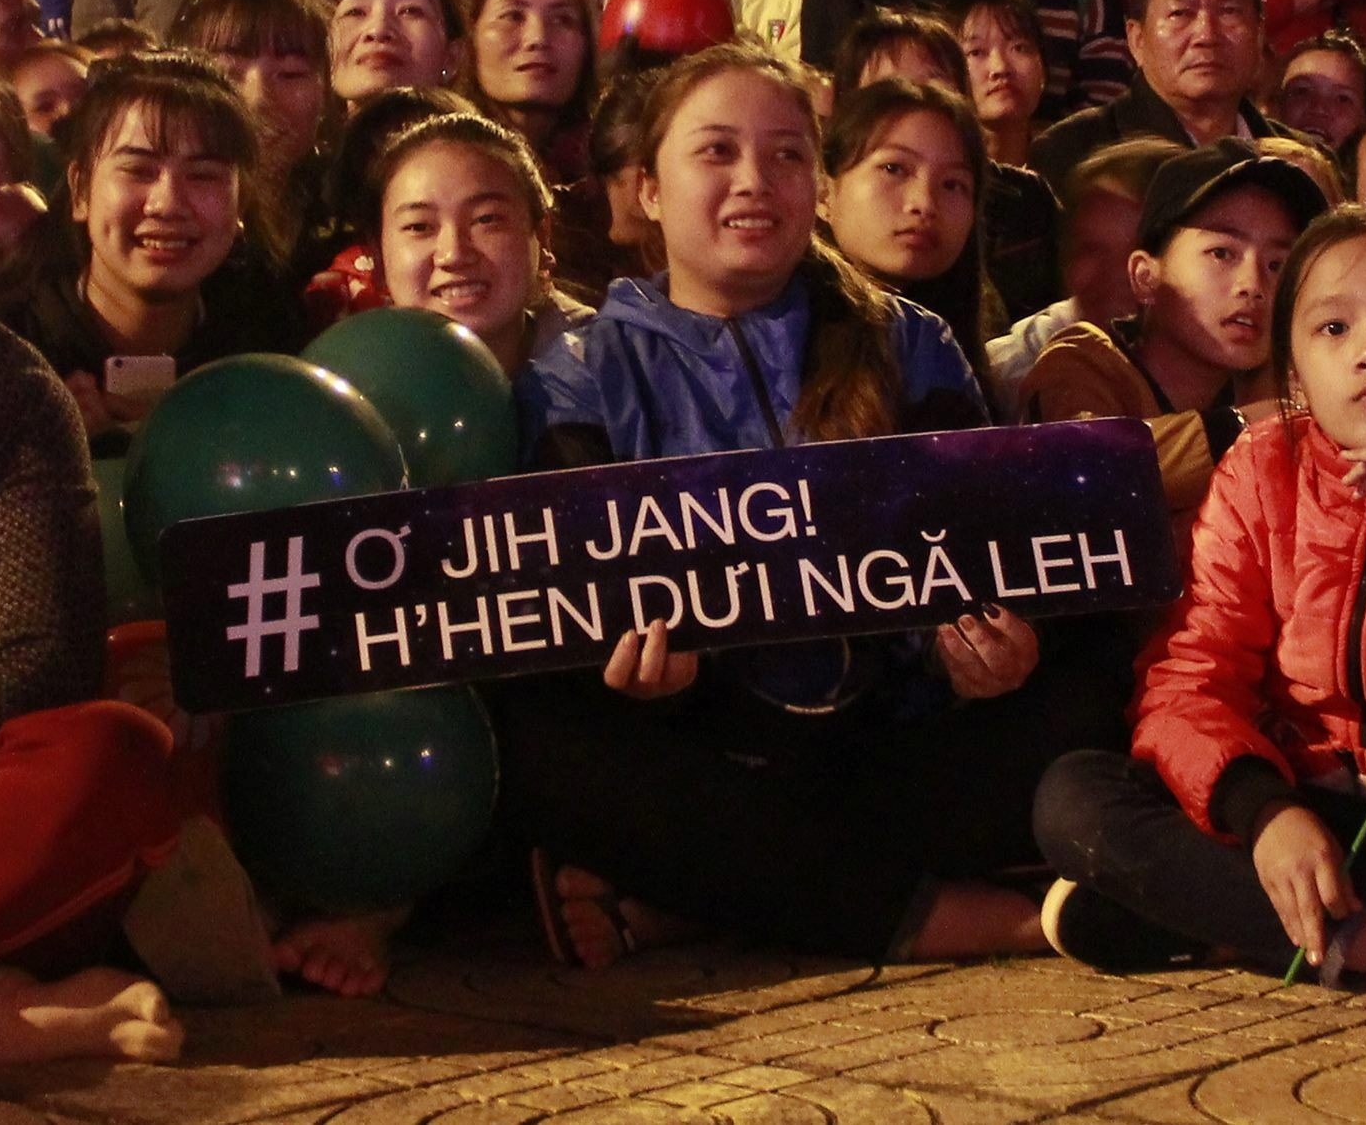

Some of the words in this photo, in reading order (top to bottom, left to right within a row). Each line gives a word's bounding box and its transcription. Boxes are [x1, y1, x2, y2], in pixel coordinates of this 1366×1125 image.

[345, 524, 412, 590] Ơ
[441, 506, 560, 579] JIH
[584, 479, 813, 561] JANG!
[354, 581, 604, 672] H'HEN
[628, 561, 775, 638] DƯI
[797, 528, 973, 617] NGĂ
[987, 529, 1134, 599] LEH
